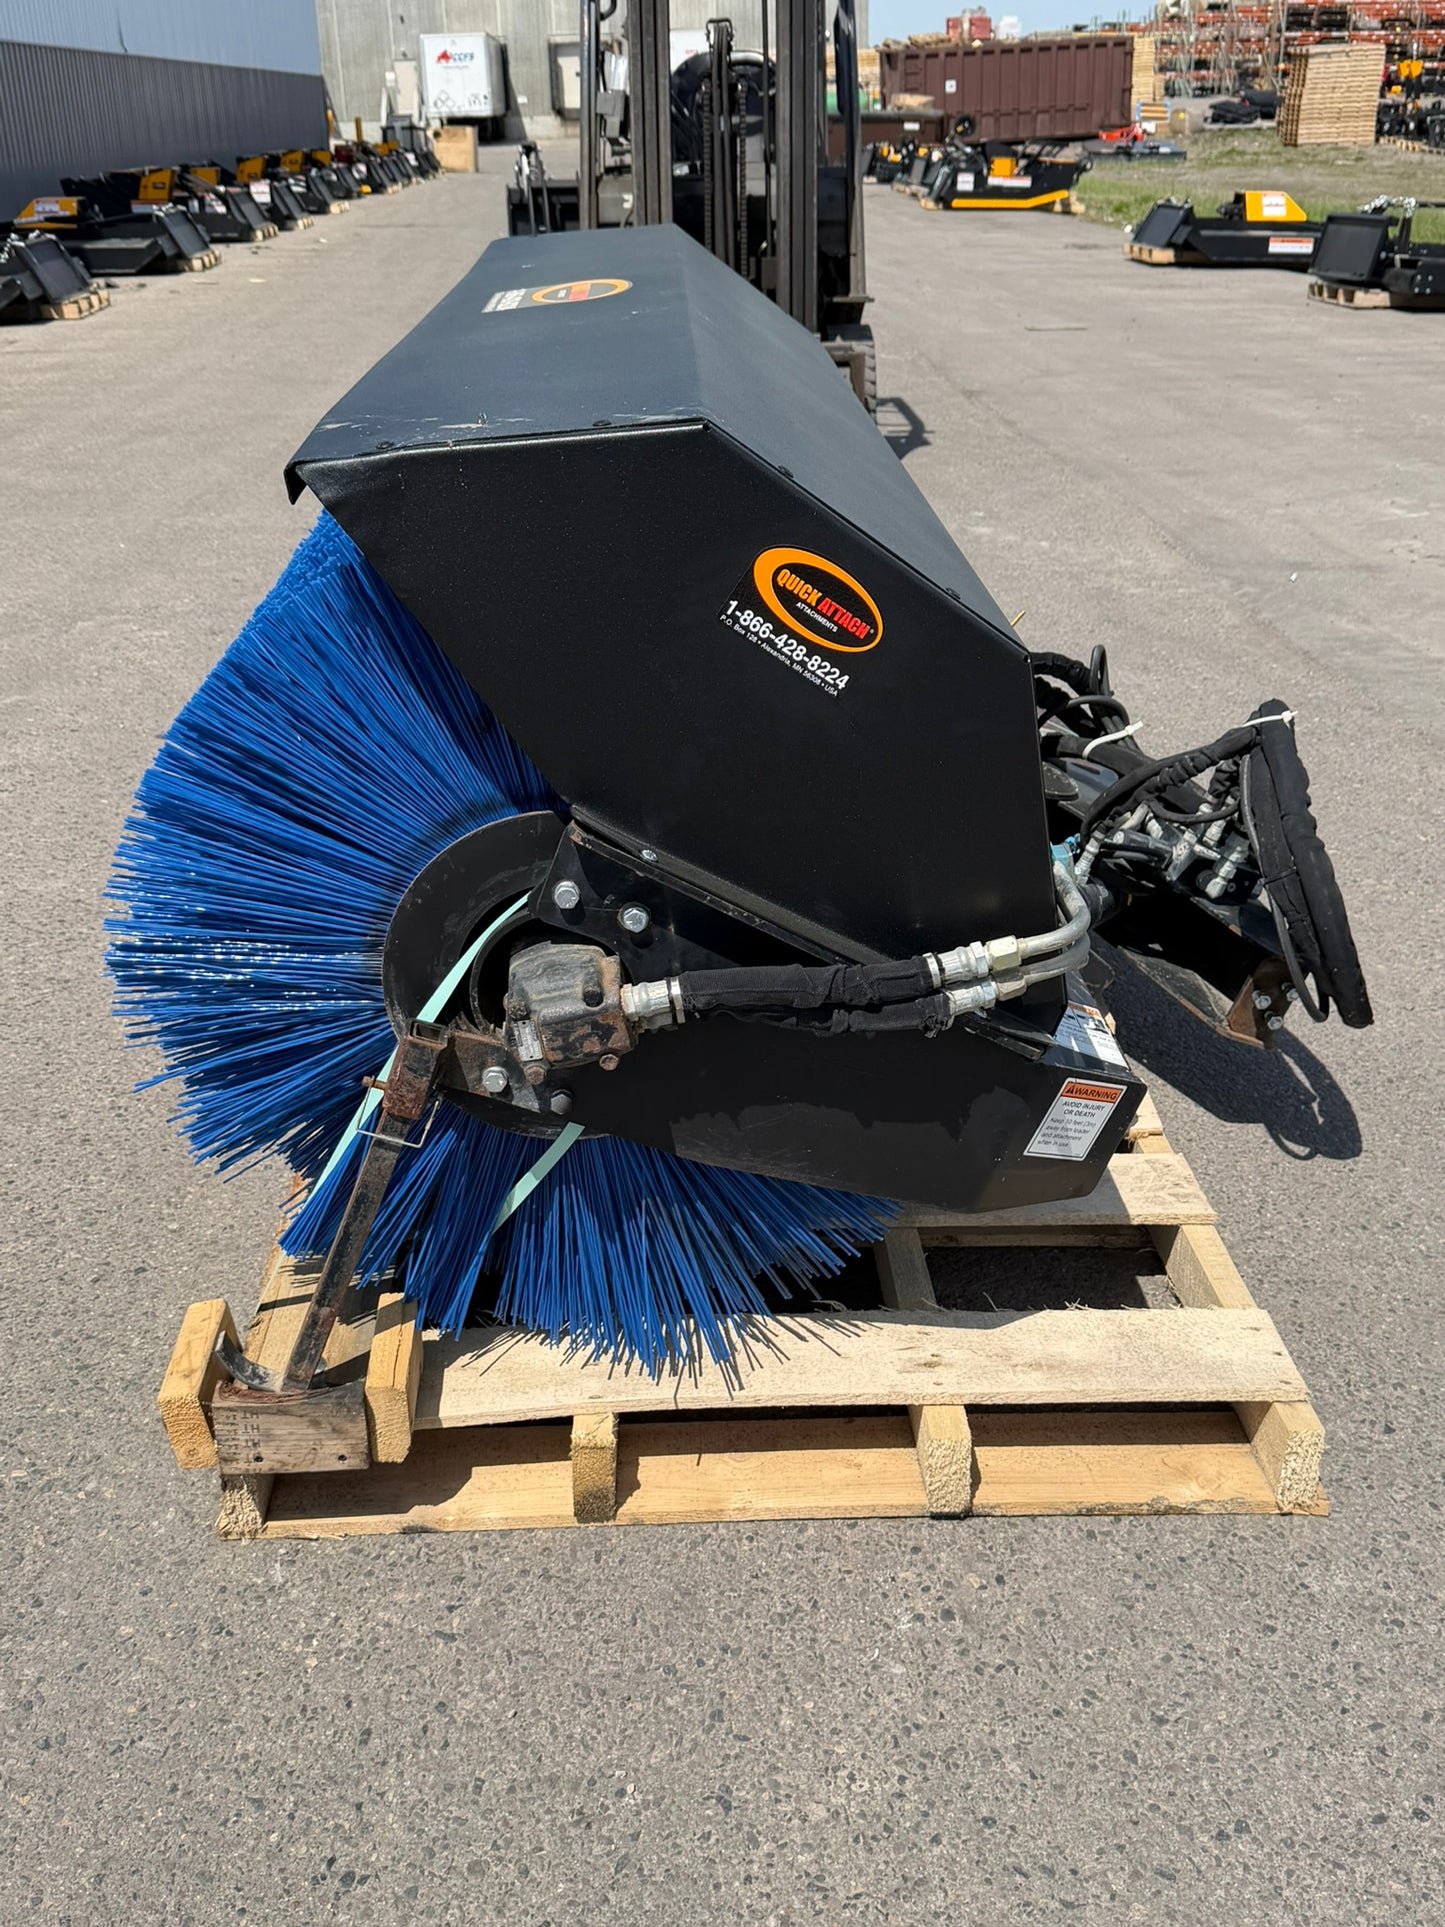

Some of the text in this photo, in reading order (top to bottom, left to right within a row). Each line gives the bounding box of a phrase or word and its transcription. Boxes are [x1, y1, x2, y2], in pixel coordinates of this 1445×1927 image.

[776, 568, 870, 640] QUICK ATTACH
[795, 602, 838, 633] ATTACHMENTS
[719, 614, 733, 626] P.O.
[734, 622, 746, 635] Box
[760, 642, 791, 667] Alexandria,
[792, 663, 803, 674] MN
[824, 684, 838, 697] USA
[726, 600, 849, 690] 1-866-428-8224
[1062, 1100, 1081, 1109] AVOID
[1075, 1088, 1118, 1100] WARNING
[1074, 1110, 1096, 1118] DEATH
